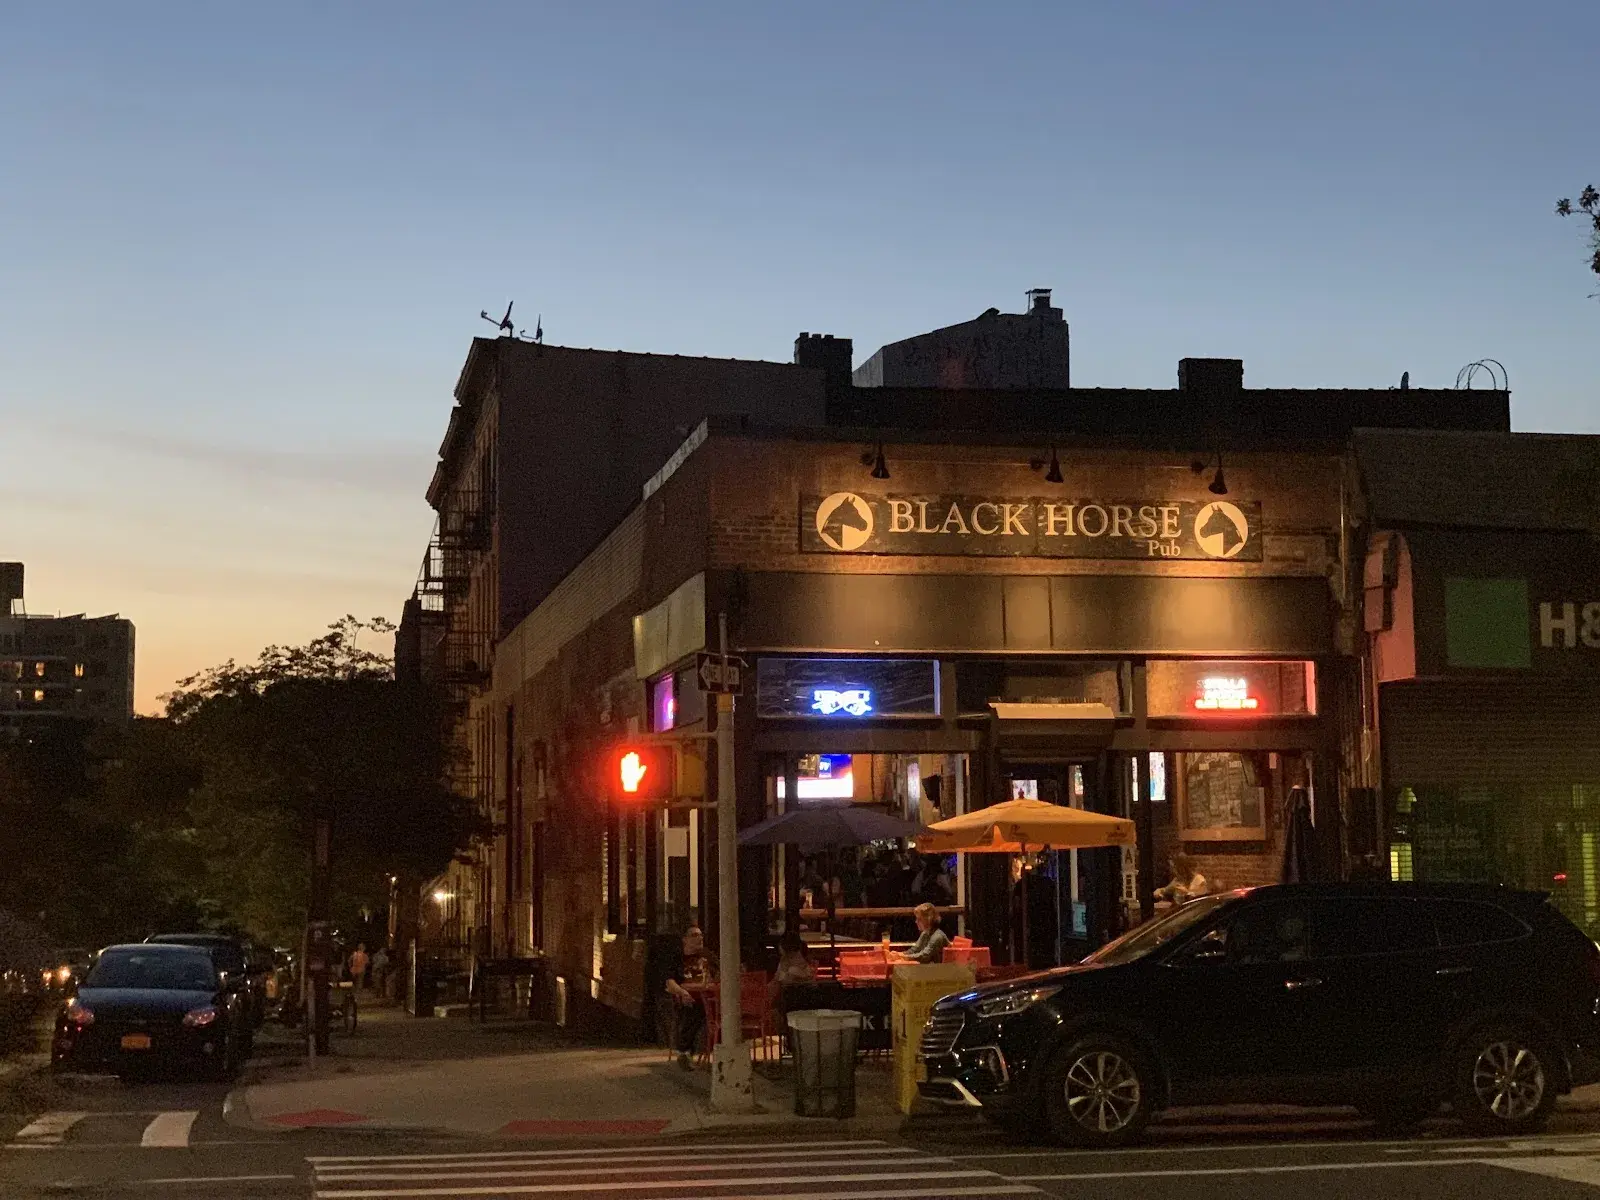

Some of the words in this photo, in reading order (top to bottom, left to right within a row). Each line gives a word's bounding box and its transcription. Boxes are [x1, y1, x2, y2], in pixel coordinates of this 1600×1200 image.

[887, 500, 1030, 536] BLACK
[1045, 504, 1182, 537] HORSE
[1148, 540, 1182, 557] Pub
